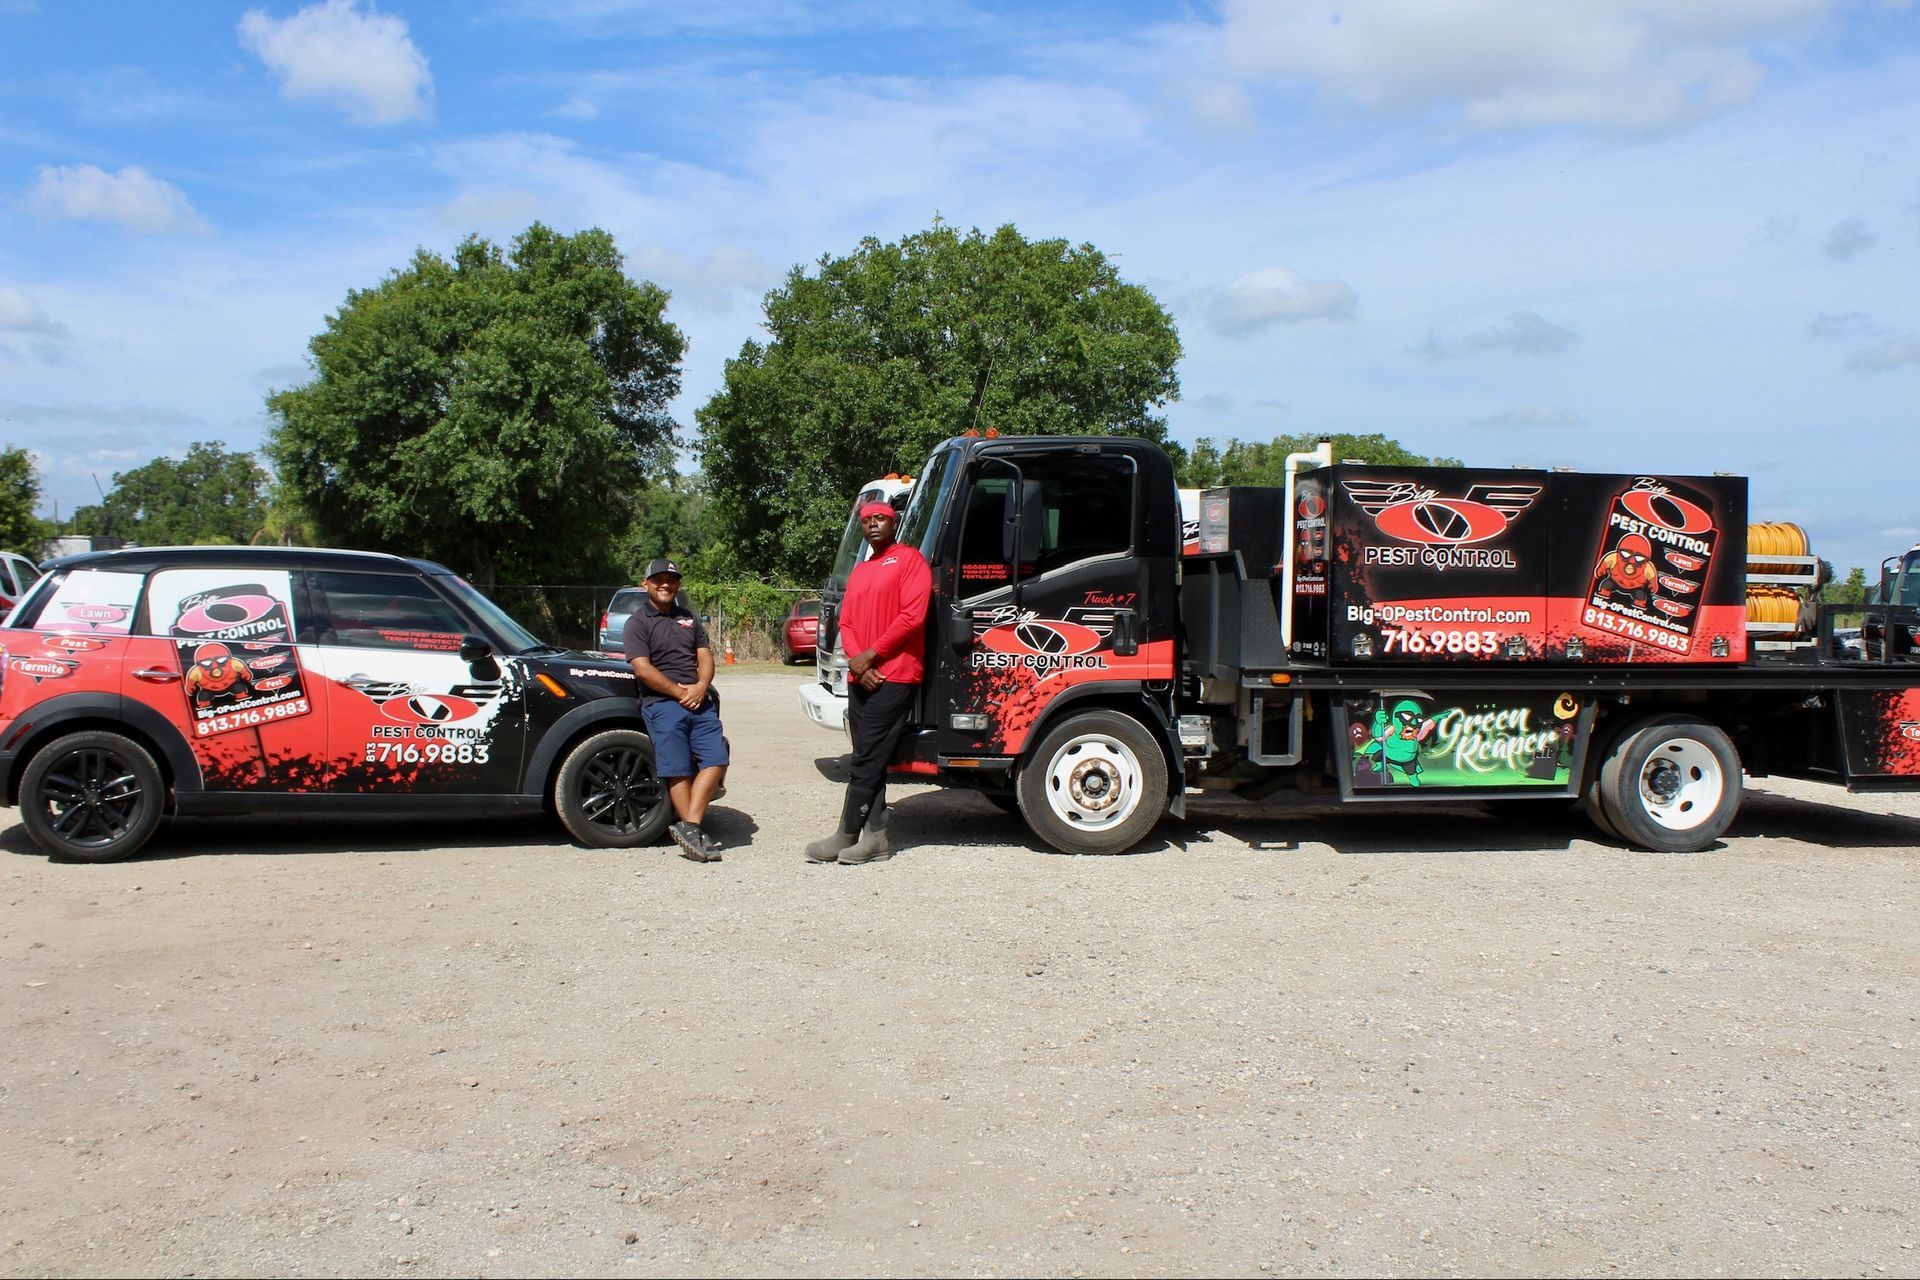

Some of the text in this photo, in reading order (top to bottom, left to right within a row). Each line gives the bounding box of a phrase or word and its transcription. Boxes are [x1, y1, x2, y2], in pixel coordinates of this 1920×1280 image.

[1386, 482, 1440, 510] Big
[1632, 476, 1671, 500] Big
[1610, 512, 1712, 556] PEST CONTROL
[1364, 547, 1516, 568] PEST CONTROL
[1674, 556, 1692, 568] Lawn
[1664, 577, 1690, 592] Termite
[181, 594, 220, 612] Big
[1083, 590, 1114, 606] Truck
[80, 608, 111, 618] Lawn
[991, 605, 1041, 630] Big
[1347, 605, 1531, 625] Big-OPestControl.com
[1592, 597, 1688, 634] Big-OPestControl.com
[1663, 603, 1679, 614] Pest
[217, 617, 286, 641] CONTROL
[1584, 609, 1689, 651] 813.716.9883
[60, 639, 88, 648] Pest
[1381, 629, 1497, 653] 716.9883
[20, 661, 64, 674] Termite
[255, 657, 283, 668] Termite
[972, 653, 1108, 670] PEST CONTROL
[265, 679, 283, 688] Pest
[387, 682, 429, 702] Big
[197, 689, 301, 719] Big-OPestControl.com
[197, 700, 308, 735] 813.716.9883
[372, 726, 487, 740] PEST CONTROL
[1431, 706, 1531, 758] Green
[366, 742, 490, 764] 813 716.9883
[1455, 731, 1560, 778] Reaper
